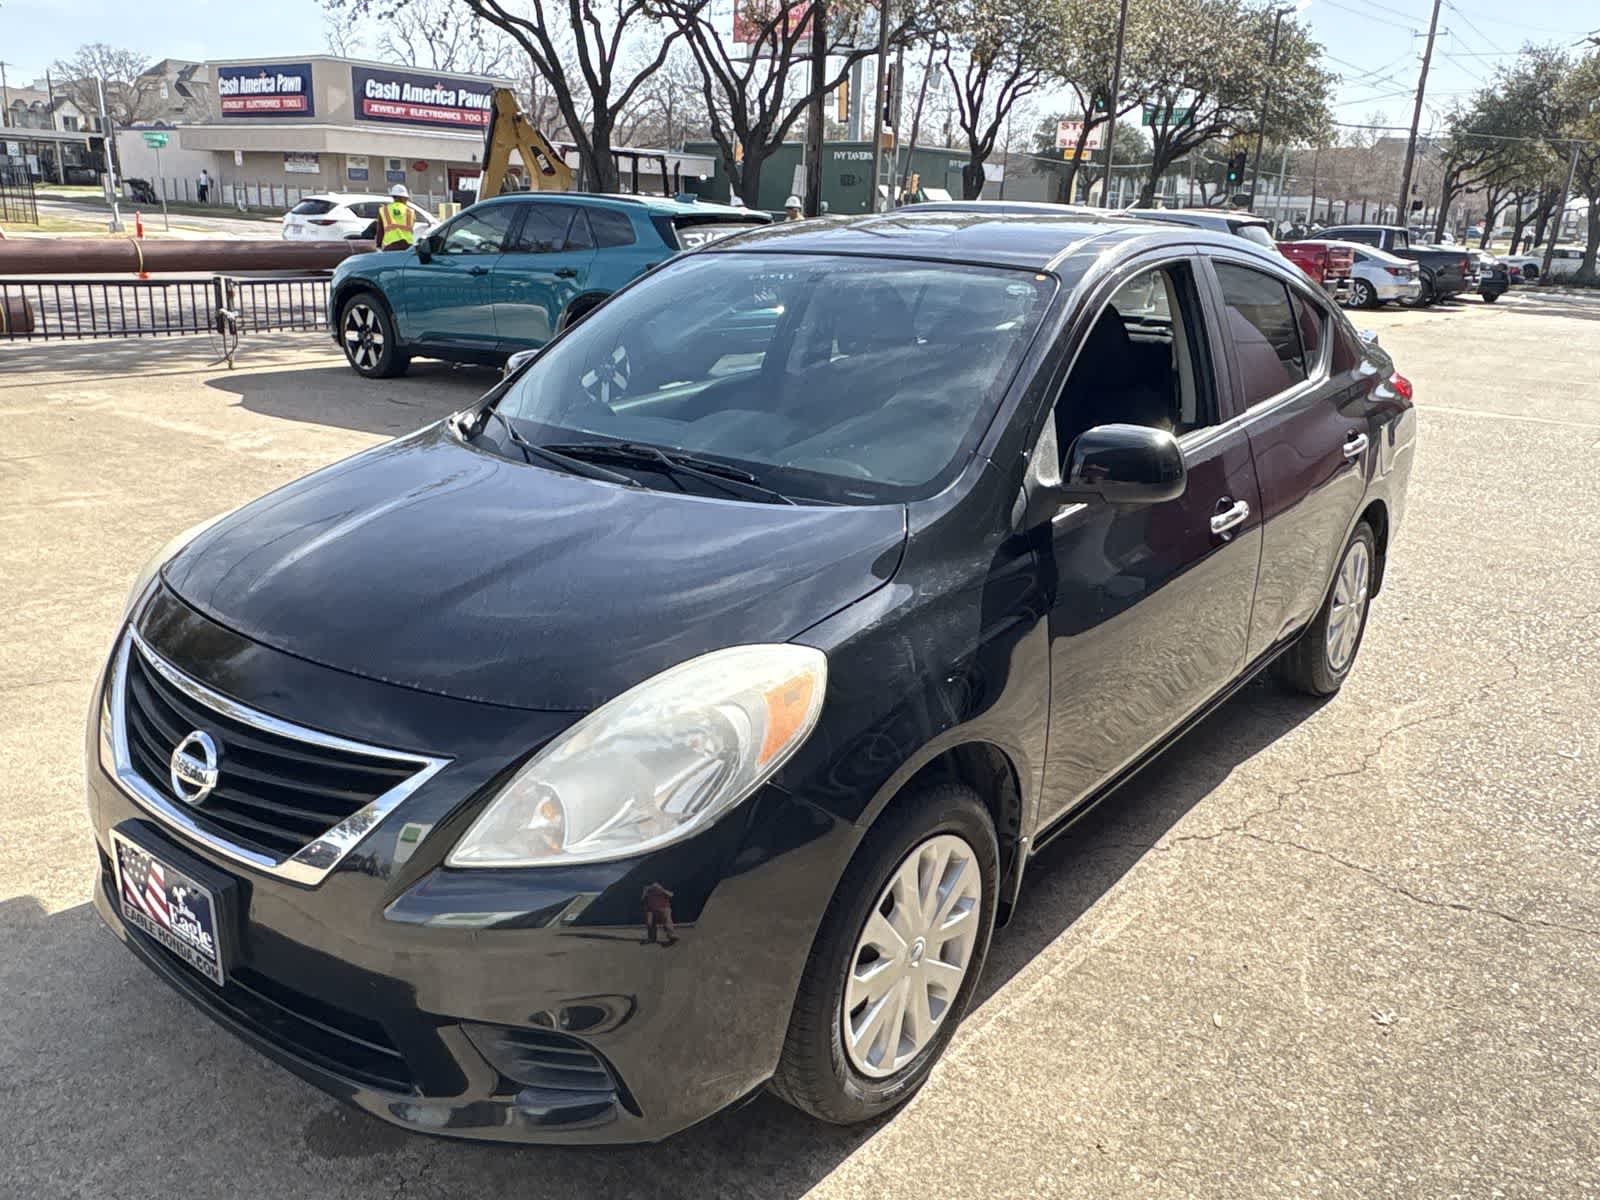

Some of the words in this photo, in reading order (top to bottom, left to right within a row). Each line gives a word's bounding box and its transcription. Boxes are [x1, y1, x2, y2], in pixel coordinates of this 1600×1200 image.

[218, 77, 239, 95] Cash
[240, 75, 275, 94] America
[277, 73, 302, 92] Pawn
[365, 79, 400, 101] Cash
[401, 83, 456, 106] America
[458, 89, 491, 109] Pawn
[369, 103, 406, 115] JEWELRY
[409, 107, 461, 121] ELECTRONICS
[1060, 121, 1098, 131] STO
[833, 151, 846, 161] IVY
[847, 151, 874, 161] TAVERN
[167, 899, 214, 949] Eagle
[125, 906, 157, 937] EAGLE
[158, 928, 220, 979] HONDA.COM
